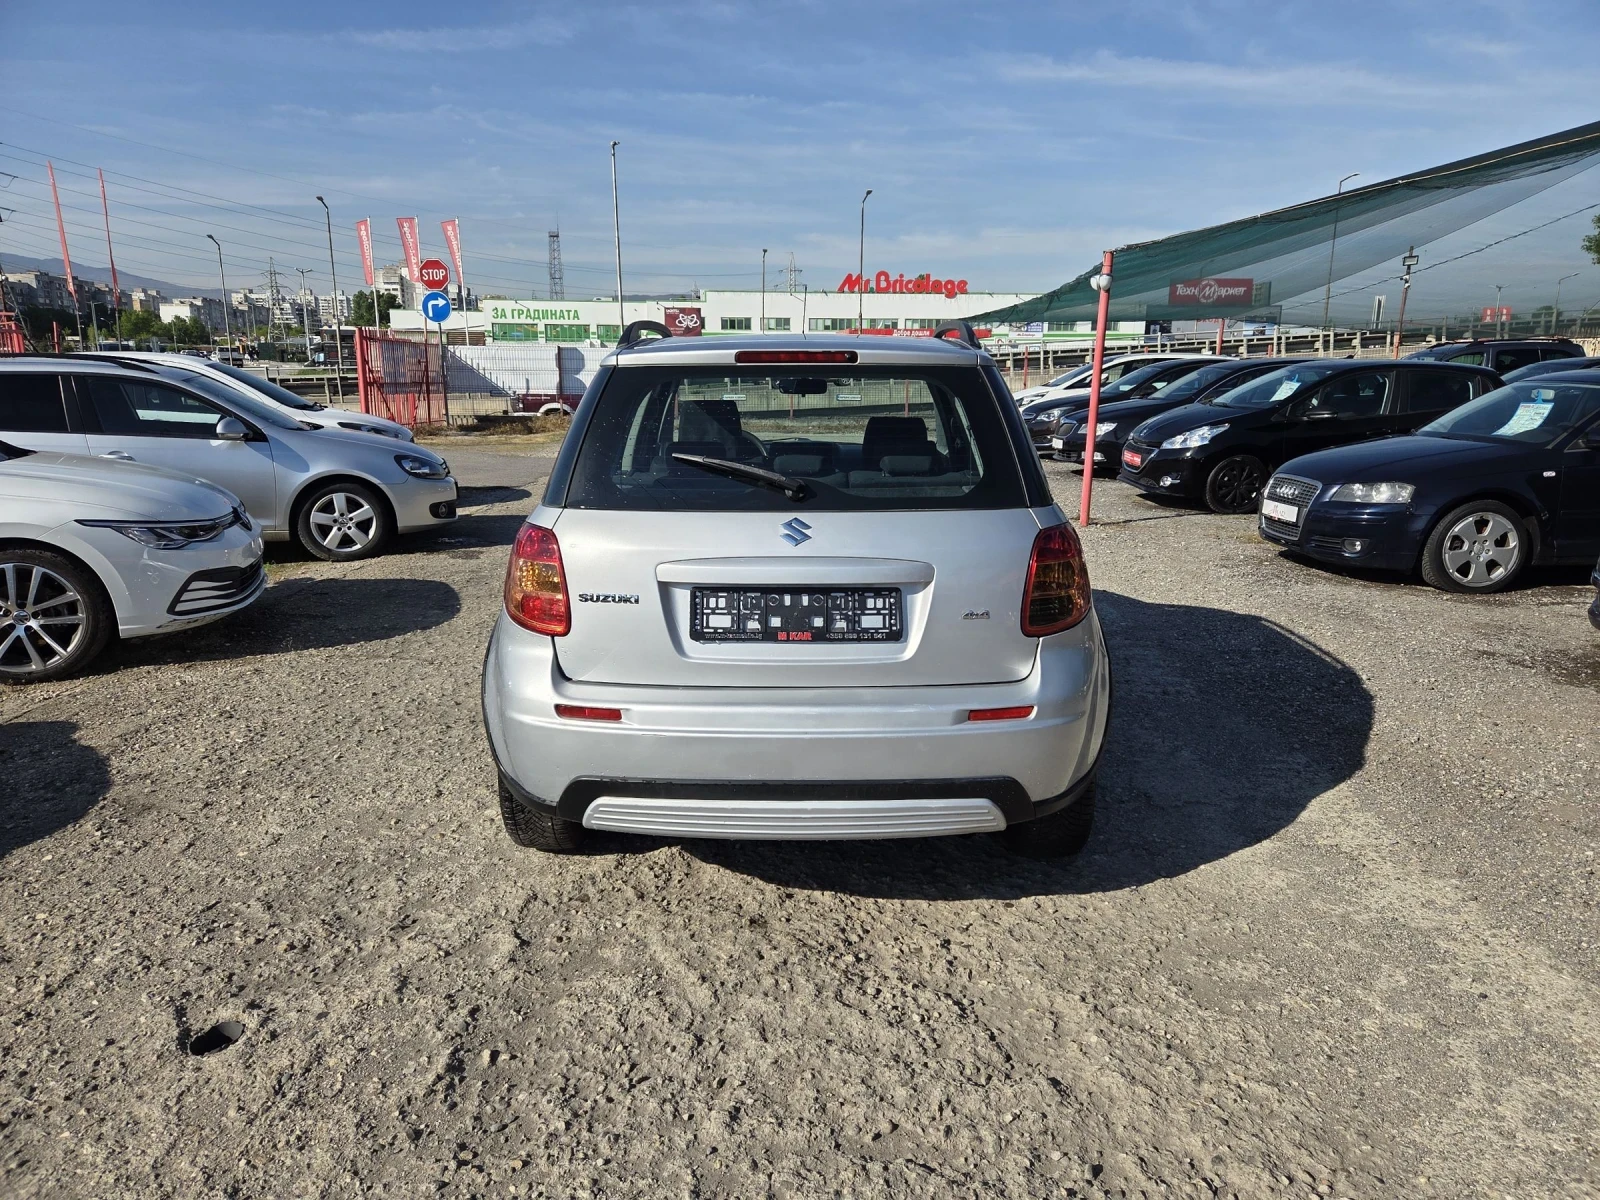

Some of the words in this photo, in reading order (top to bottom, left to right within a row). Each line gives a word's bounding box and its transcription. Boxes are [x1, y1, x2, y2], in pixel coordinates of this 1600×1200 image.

[422, 269, 446, 281] STOP
[492, 307, 508, 319] ЗА
[511, 308, 580, 321] ГРАДИНАТА
[893, 329, 910, 338] Добре
[911, 330, 930, 338] дошли
[578, 593, 640, 604] SUZUKI
[789, 631, 812, 641] KAR
